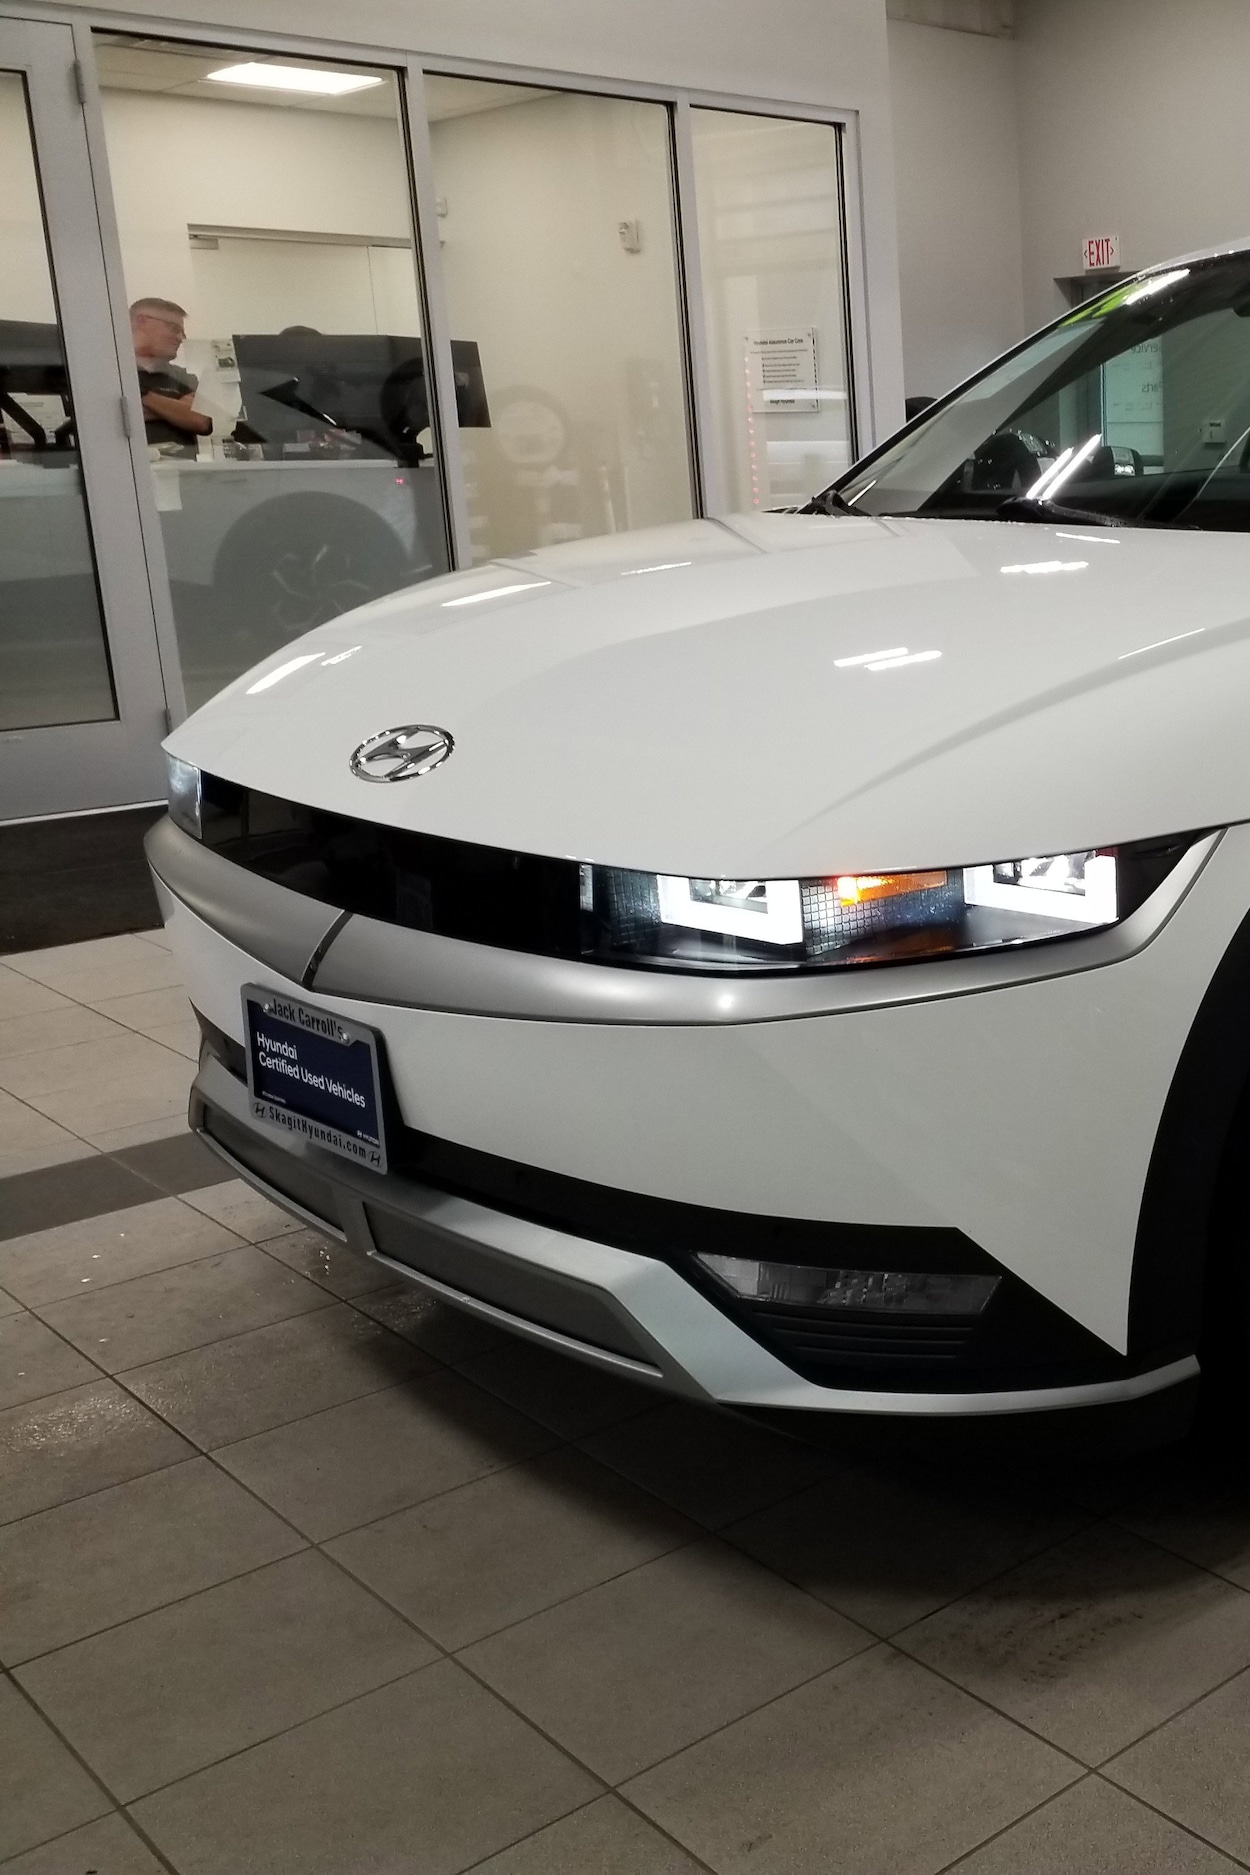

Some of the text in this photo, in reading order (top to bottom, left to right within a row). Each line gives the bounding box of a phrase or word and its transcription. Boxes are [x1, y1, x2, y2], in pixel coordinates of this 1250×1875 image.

[1088, 238, 1110, 267] EXIT
[271, 999, 343, 1041] Jack Carroll's
[257, 1031, 298, 1060] Hyundai
[259, 1051, 365, 1108] Certified Used Vehicles
[269, 1106, 366, 1158] SkagitHyundai.com
